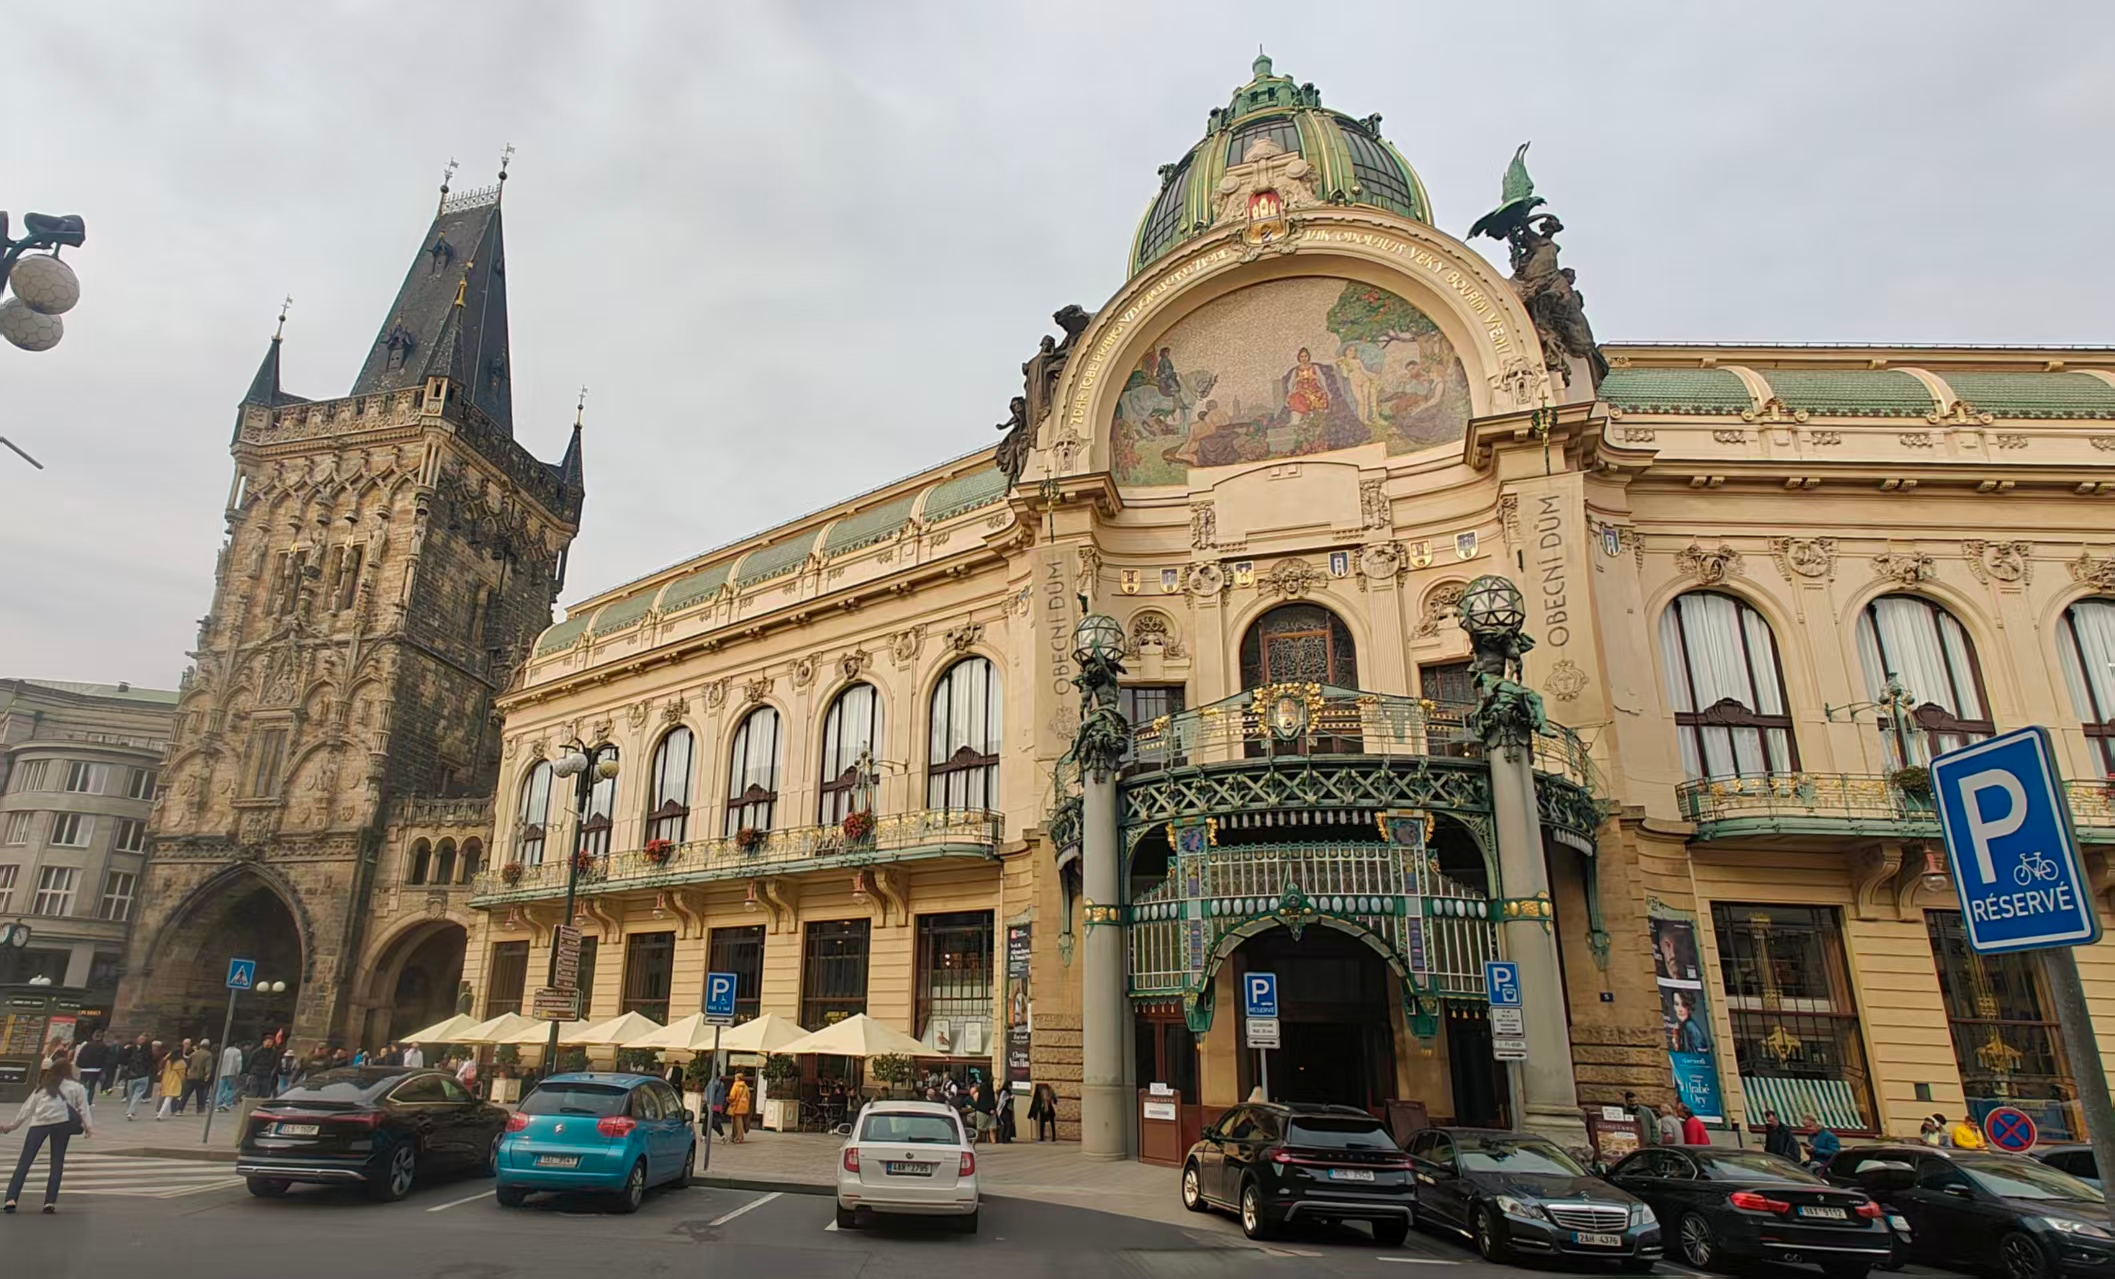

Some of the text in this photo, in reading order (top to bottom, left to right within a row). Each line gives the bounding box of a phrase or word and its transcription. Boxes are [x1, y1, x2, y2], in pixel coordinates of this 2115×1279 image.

[1043, 560, 1065, 610] DŮM
[1533, 495, 1570, 647] OBECNÍ DŮM
[1957, 768, 2028, 885] P
[1971, 881, 2075, 922] RÉSERVÉ
[712, 978, 729, 1002] P
[1252, 979, 1269, 1003] P
[1492, 967, 1511, 992] P
